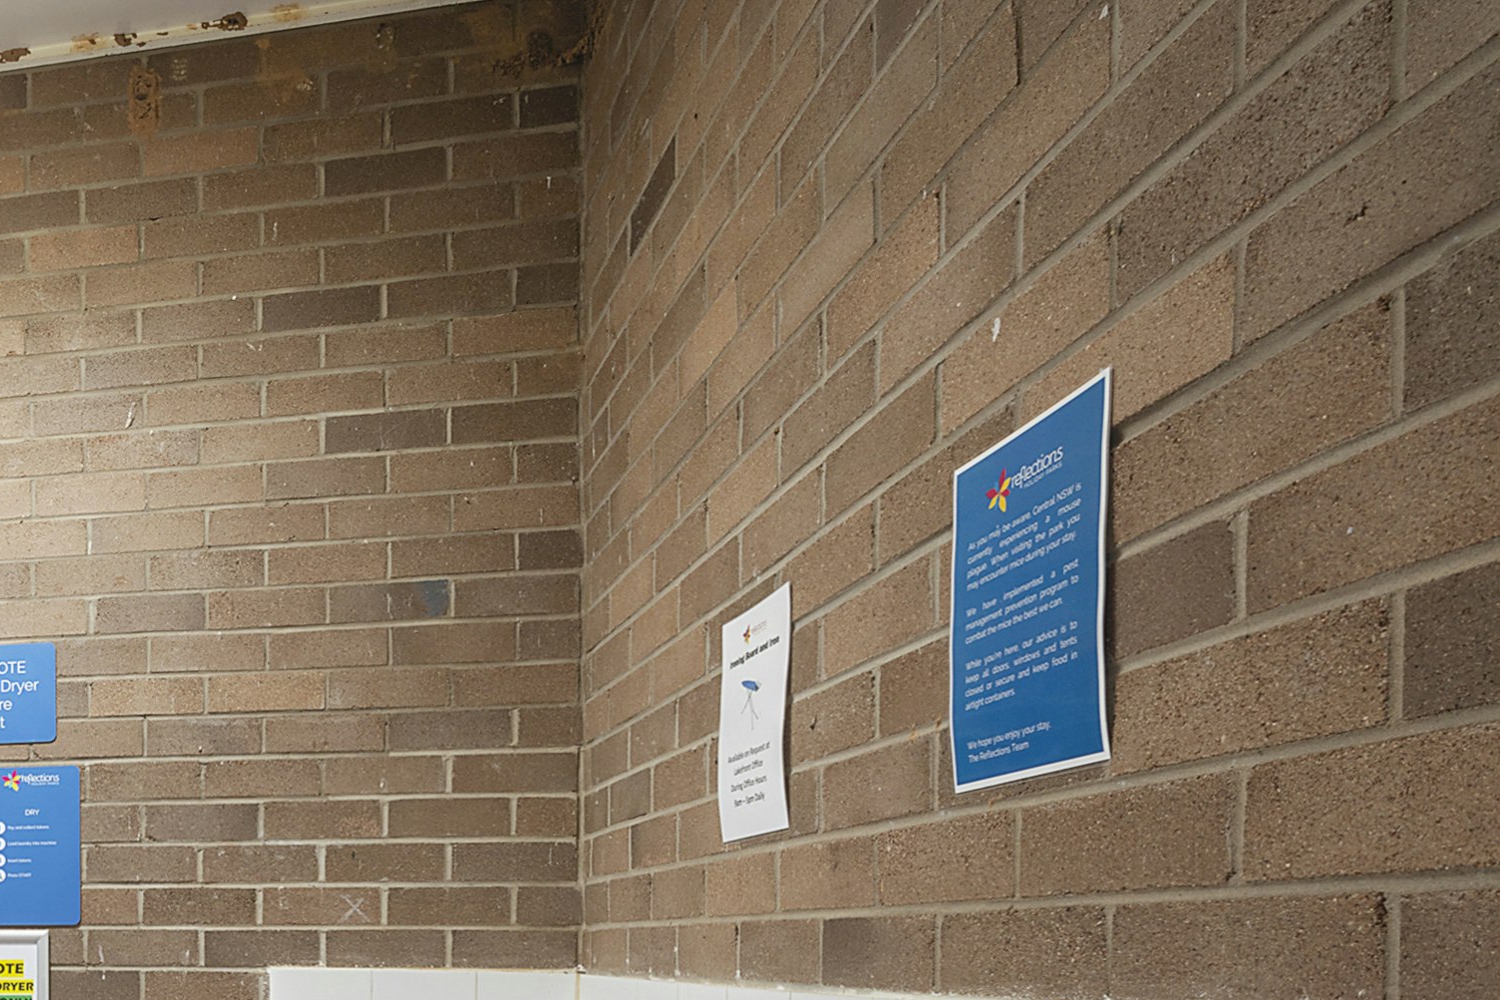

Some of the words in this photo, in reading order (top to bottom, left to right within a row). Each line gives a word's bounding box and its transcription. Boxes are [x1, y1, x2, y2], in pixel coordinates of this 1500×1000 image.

[1011, 446, 1064, 488] reflections
[0, 679, 39, 696] Dryer
[20, 774, 60, 784] reflections
